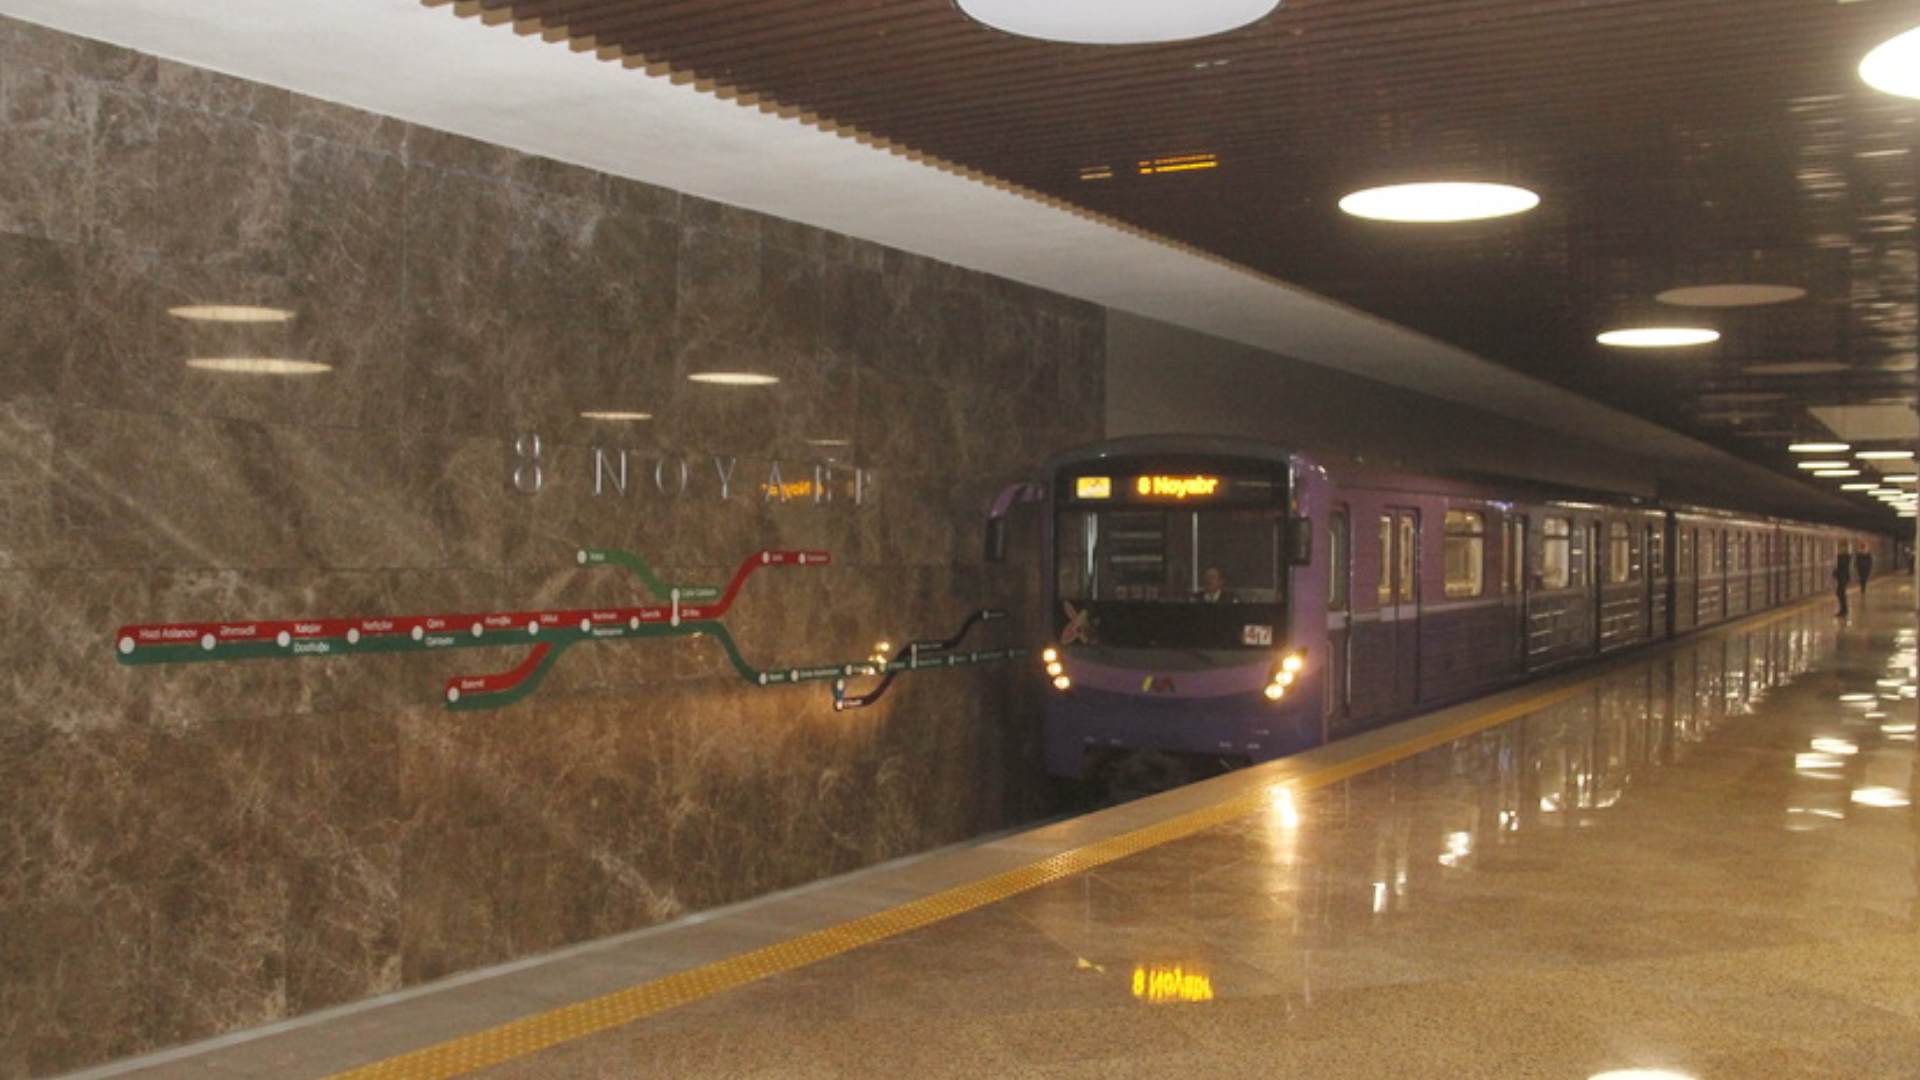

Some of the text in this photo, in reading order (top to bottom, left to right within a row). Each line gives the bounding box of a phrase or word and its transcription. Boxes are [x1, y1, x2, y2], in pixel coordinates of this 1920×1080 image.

[514, 433, 542, 495] 8
[1137, 475, 1218, 498] 8 Noyabr
